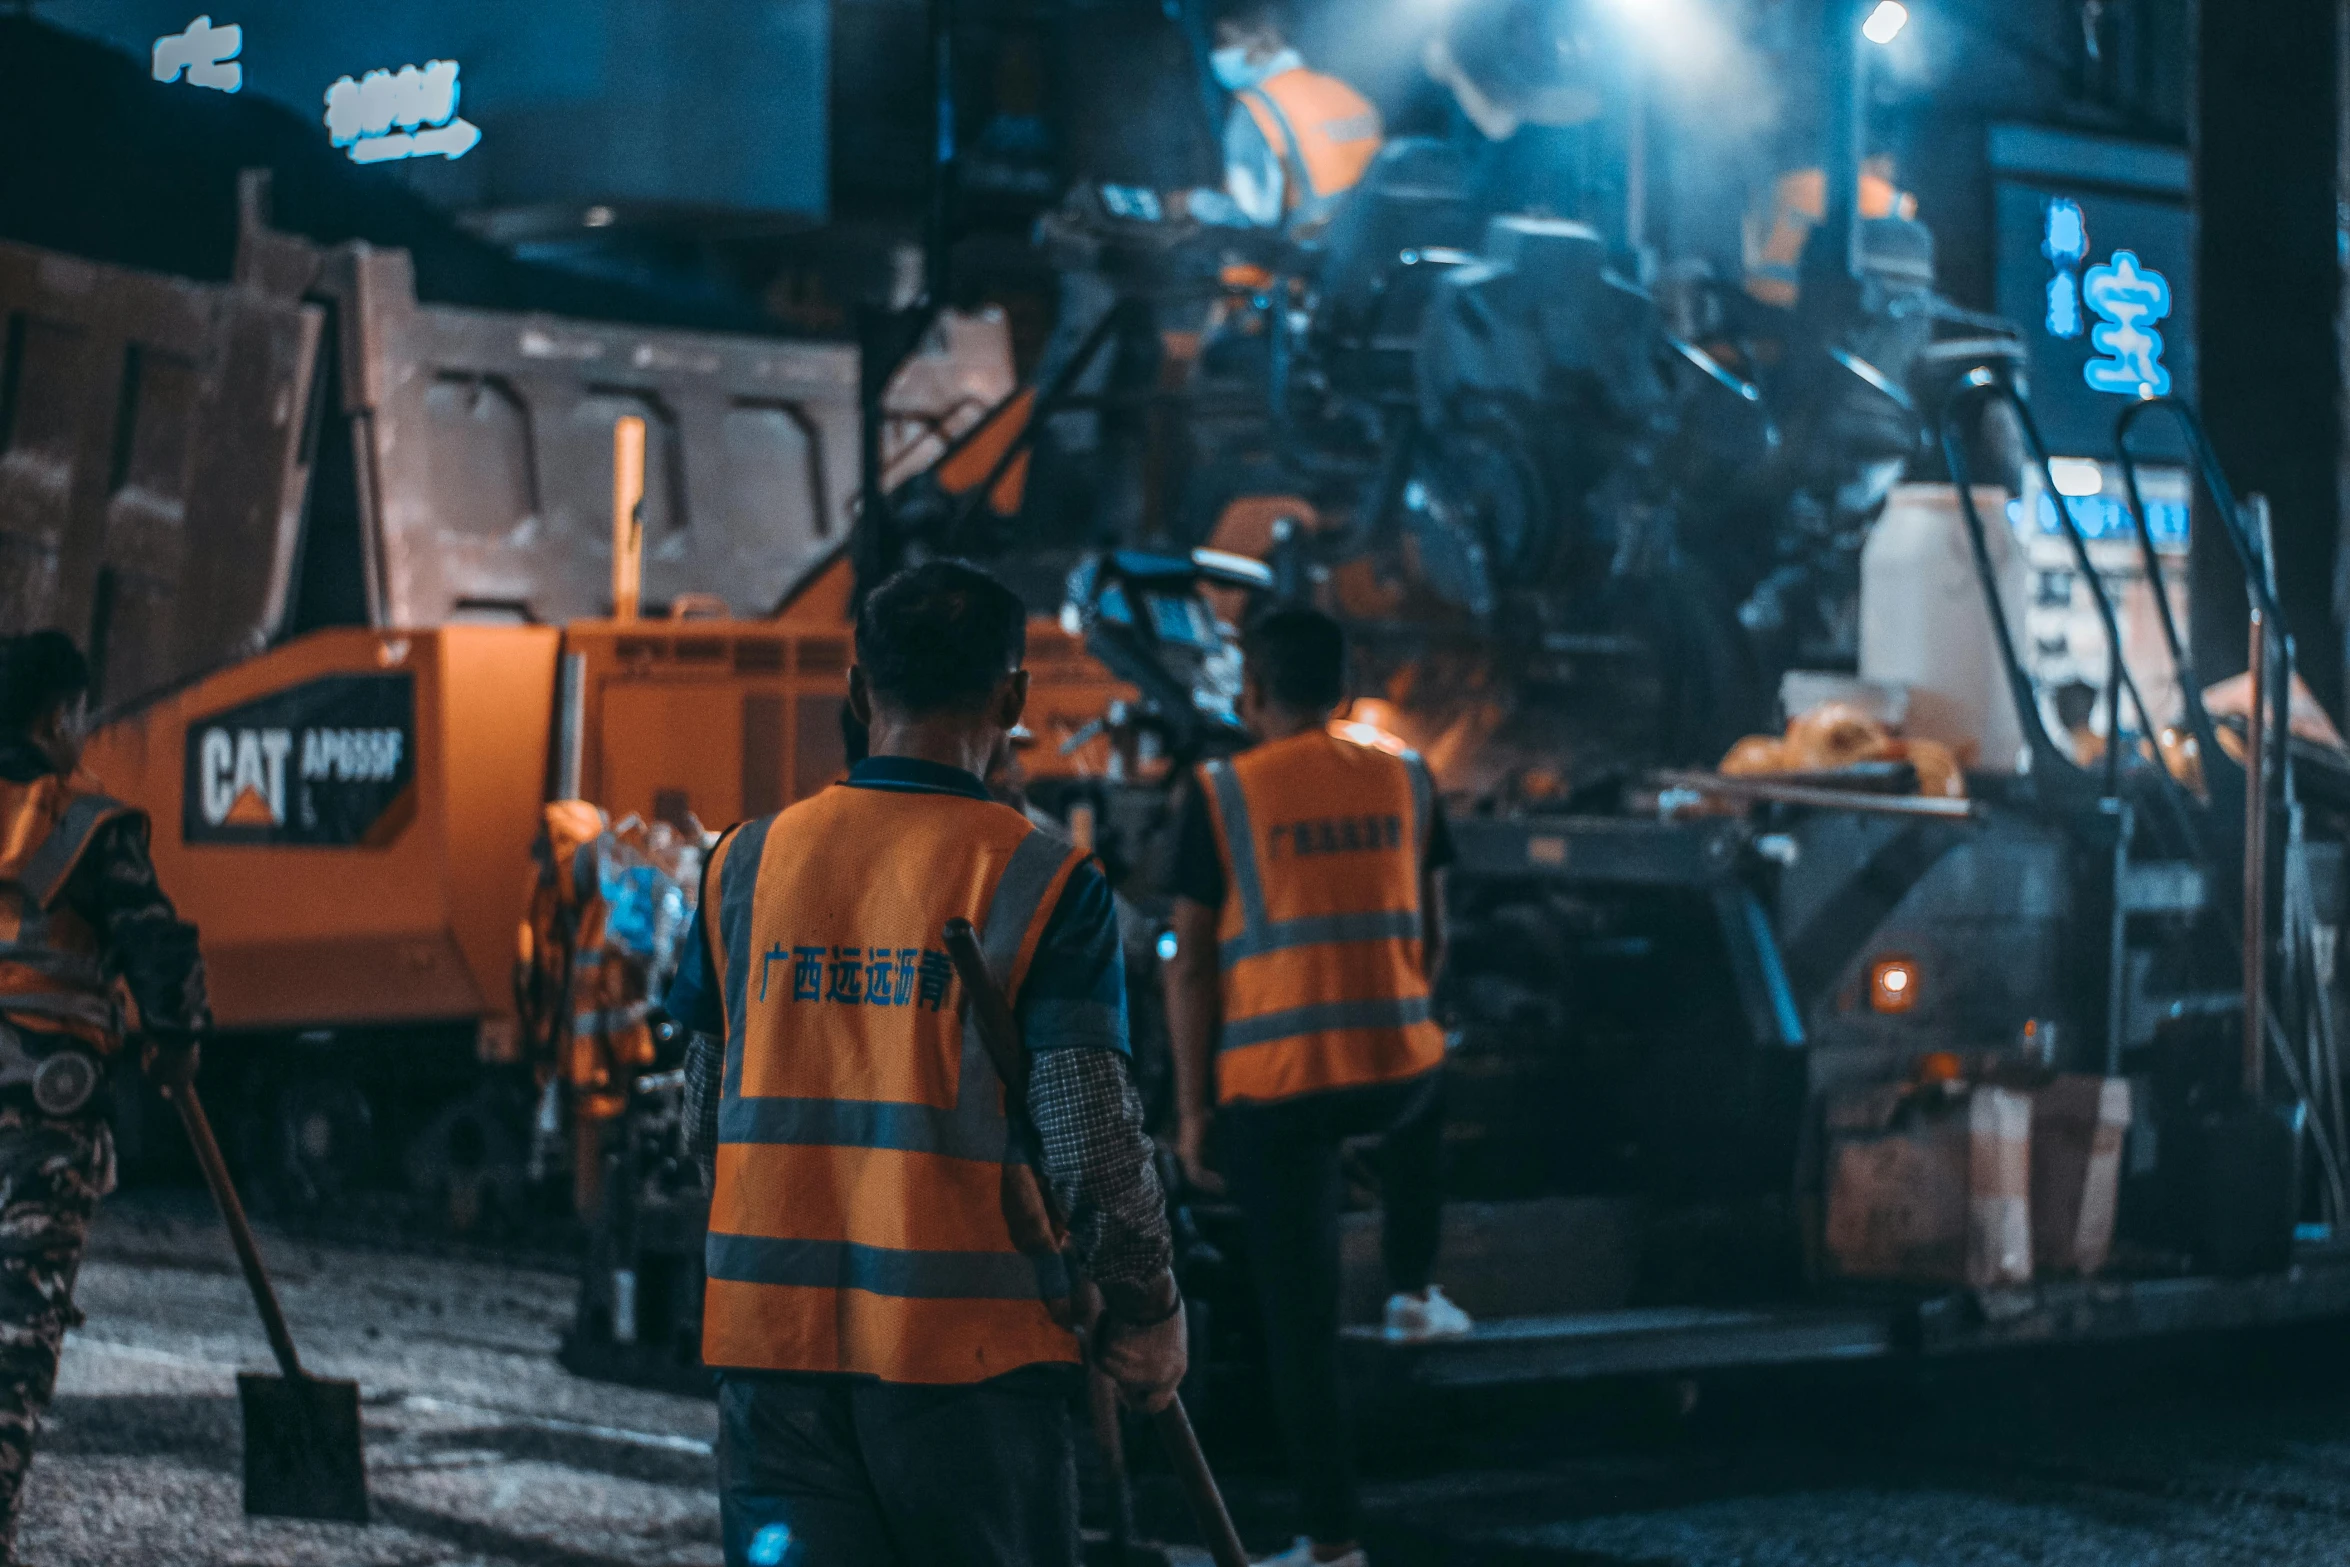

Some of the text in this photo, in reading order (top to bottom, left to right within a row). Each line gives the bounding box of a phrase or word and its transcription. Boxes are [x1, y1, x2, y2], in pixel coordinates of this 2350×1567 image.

[201, 727, 292, 826] CAT
[759, 941, 954, 1012] 广西远远沥青
